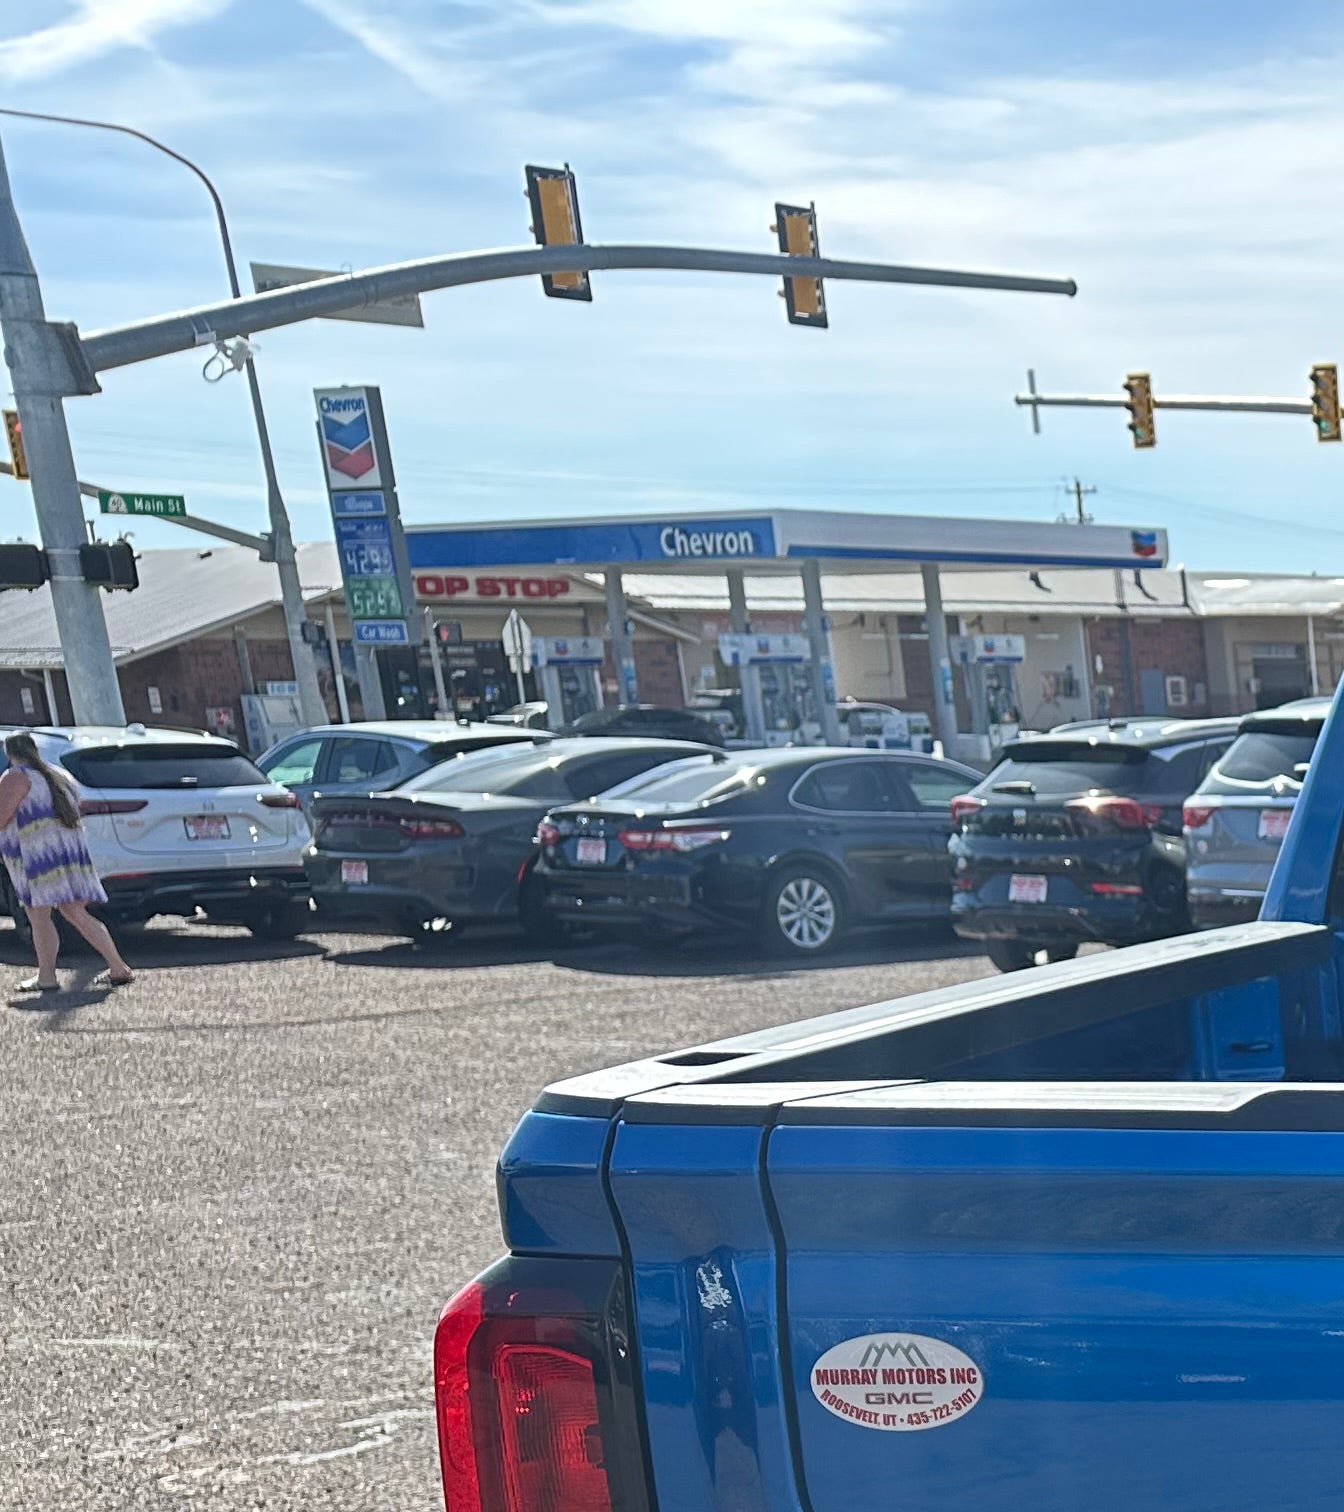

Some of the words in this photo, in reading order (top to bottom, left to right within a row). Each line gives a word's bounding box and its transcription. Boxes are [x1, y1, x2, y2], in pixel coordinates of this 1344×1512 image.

[319, 397, 366, 413] Chevron
[134, 496, 164, 512] Main
[167, 498, 182, 513] St
[660, 526, 754, 557] Chevron
[412, 575, 469, 596] OP
[475, 577, 569, 597] STOP
[815, 1369, 878, 1386] MURRAY
[882, 1368, 947, 1385] MOTORS
[950, 1367, 978, 1385] INC
[820, 1388, 881, 1427] ROOSEVELT,
[882, 1413, 897, 1427] UT
[906, 1387, 978, 1426] 435-722-5107
[865, 1392, 934, 1405] GMC
